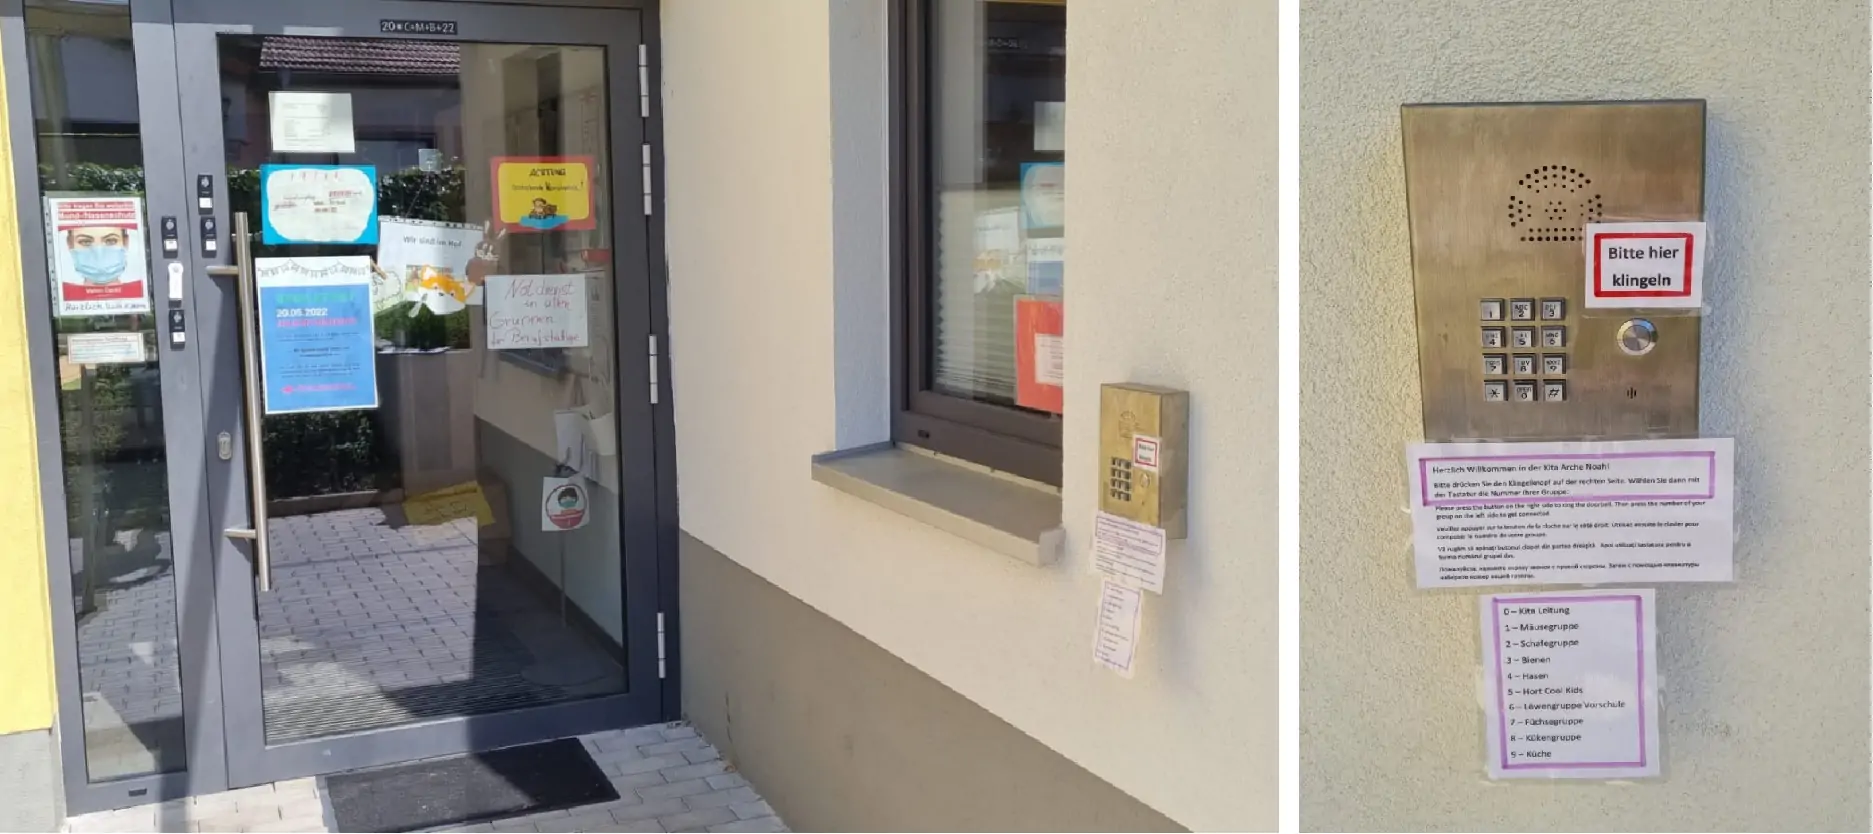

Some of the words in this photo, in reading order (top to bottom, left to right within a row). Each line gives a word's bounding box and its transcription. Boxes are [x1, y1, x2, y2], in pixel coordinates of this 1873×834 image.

[403, 236, 416, 244] Wir
[1608, 247, 1645, 260] Bitte
[1649, 246, 1679, 259] hier
[1612, 273, 1671, 289] klingeln
[276, 307, 328, 318] 20.05.2022
[1518, 310, 1524, 318] 2
[1432, 466, 1465, 474] Herzlich
[1466, 465, 1517, 473] Willkommen
[1519, 464, 1526, 472] in
[1528, 464, 1541, 472] der
[1543, 464, 1559, 472] Kita
[1561, 463, 1584, 471] Arche
[1586, 462, 1610, 471] Noah!
[1509, 479, 1551, 488] Klingelknopf
[1541, 489, 1570, 497] Gruppe:
[1503, 608, 1510, 616] 0
[1519, 607, 1536, 615] Kita
[1538, 606, 1570, 615] Leitung
[1505, 624, 1510, 632] 1
[1520, 622, 1579, 633] Mäusegruppe
[1520, 639, 1579, 649] Schafegruppe
[1508, 688, 1513, 696] 5
[1544, 687, 1563, 695] Cool
[1565, 686, 1583, 694] Kids
[1524, 702, 1582, 711] Löwengruppe
[1583, 700, 1626, 709] Vorschule
[1510, 718, 1516, 726] 7
[1525, 718, 1584, 726] Füchsegruppe
[1525, 734, 1582, 743] Kükengruppe
[1526, 750, 1552, 758] Küche
